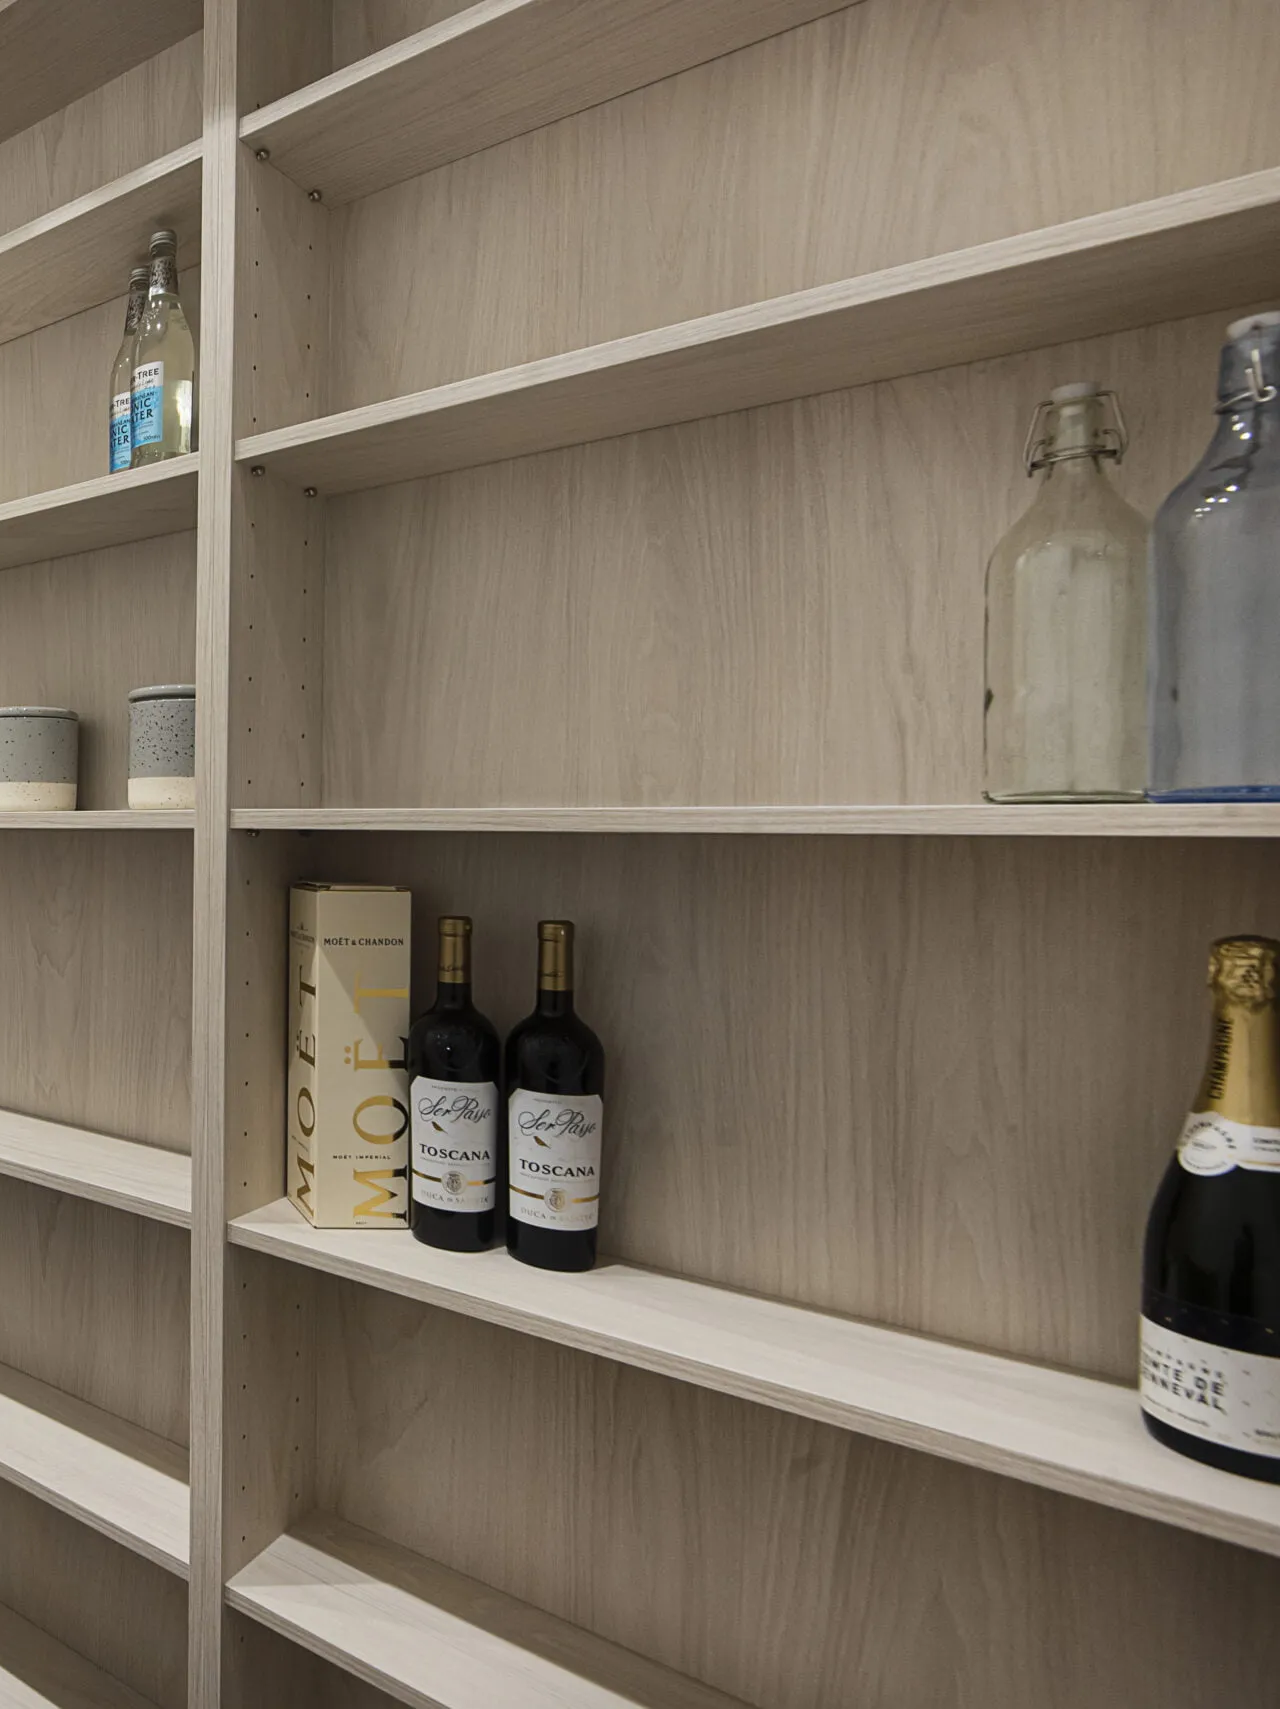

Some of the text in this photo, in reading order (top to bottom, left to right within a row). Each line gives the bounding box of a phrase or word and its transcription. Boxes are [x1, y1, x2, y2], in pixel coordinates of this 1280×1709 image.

[323, 937, 349, 946] MOËT
[358, 938, 404, 946] CHANDON
[296, 964, 316, 1218] MOËT
[344, 970, 408, 1222] MOËT
[419, 1143, 490, 1161] TOSCANA
[519, 1158, 595, 1177] TOSCANA
[1193, 1375, 1225, 1397] DE
